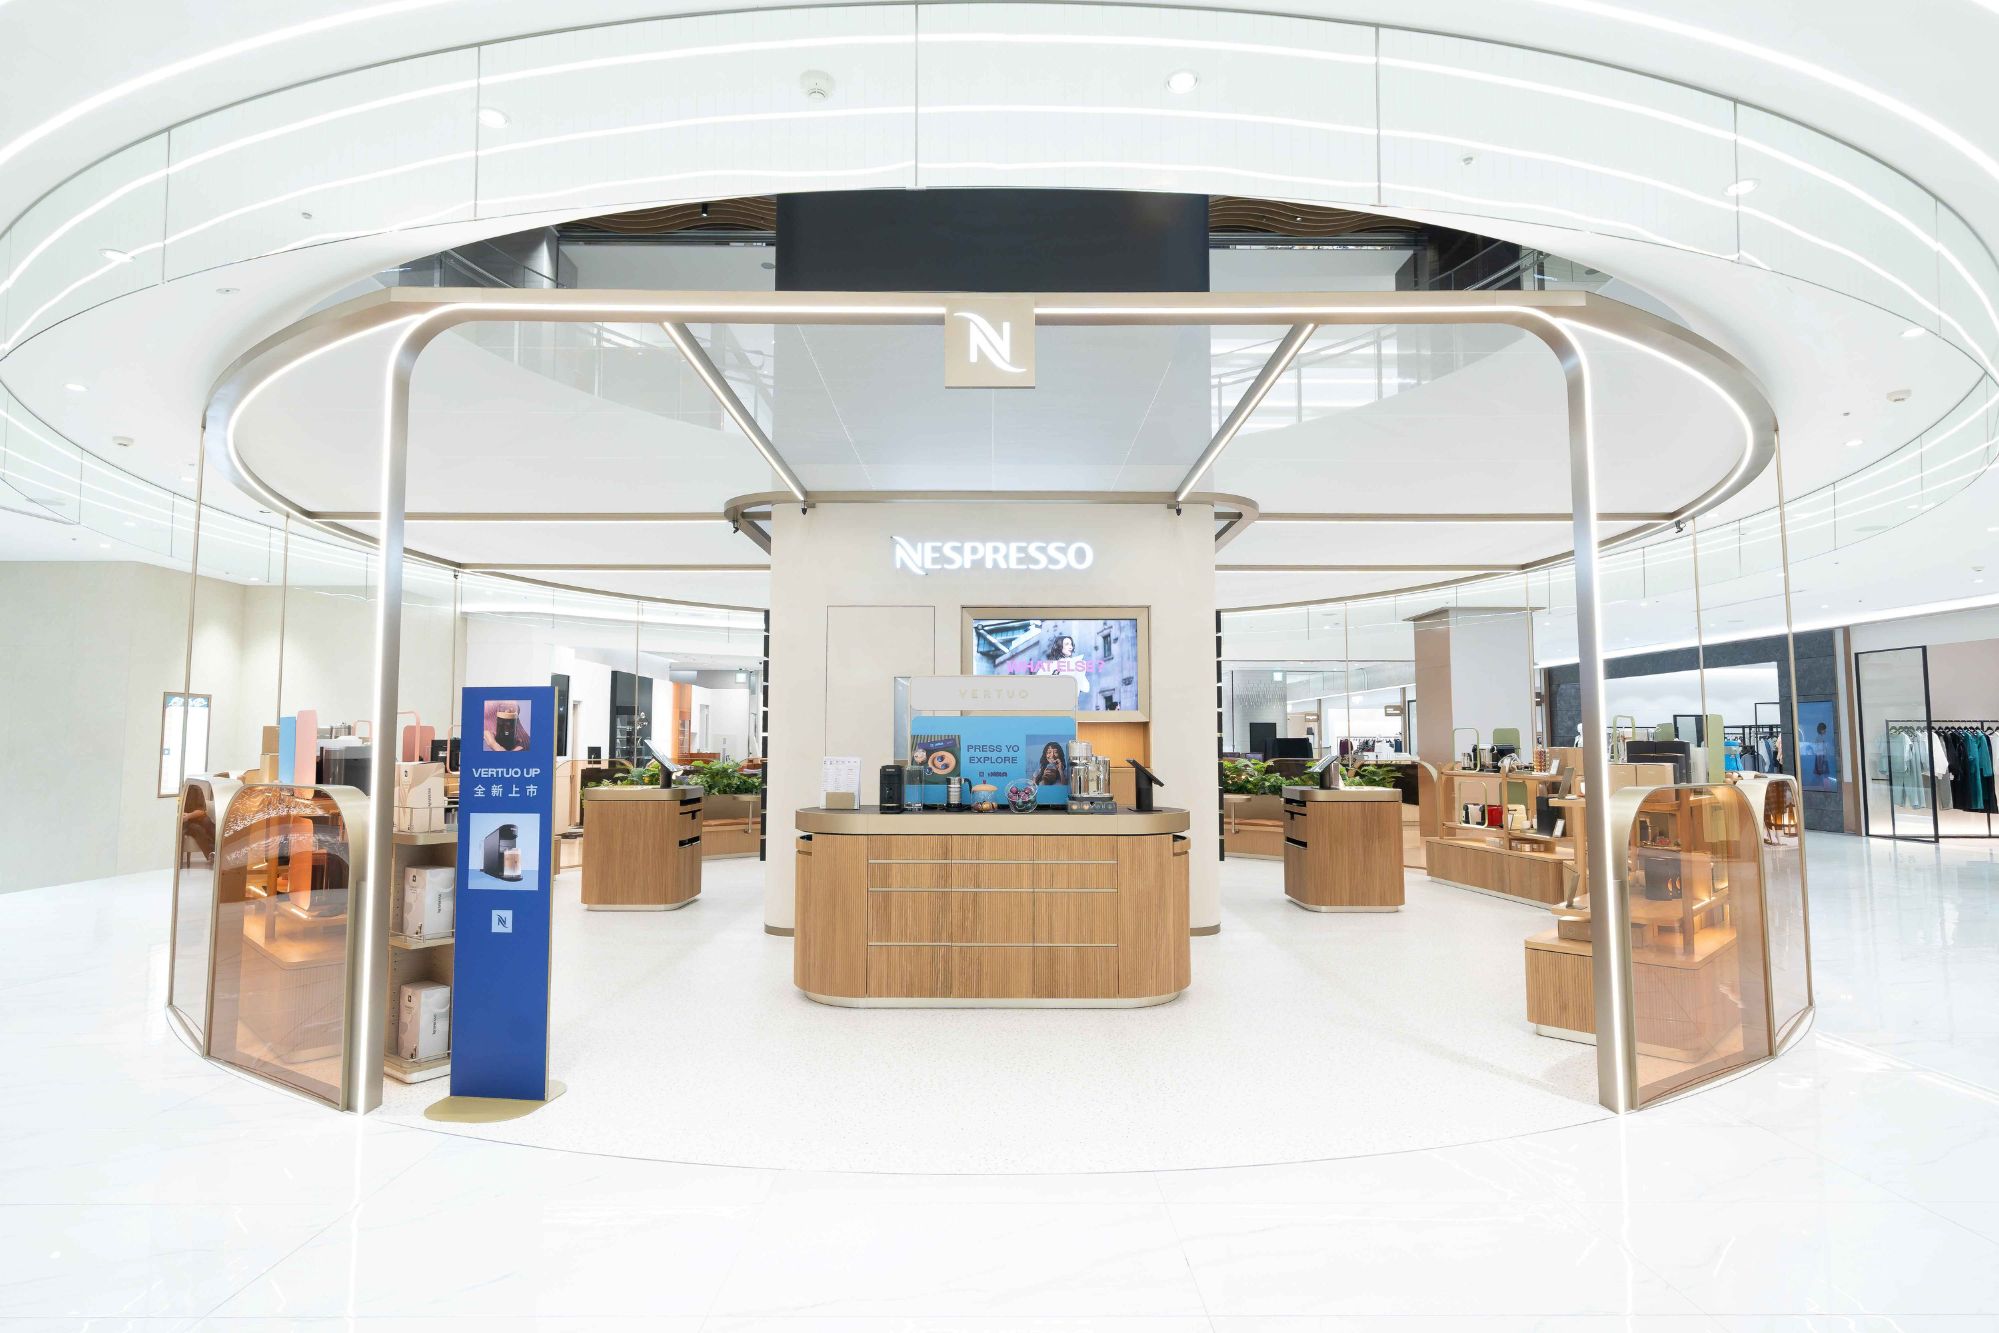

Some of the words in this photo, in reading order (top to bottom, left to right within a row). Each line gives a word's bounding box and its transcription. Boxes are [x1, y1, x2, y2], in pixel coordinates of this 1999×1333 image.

[890, 535, 1095, 576] NESPRESSO
[1006, 660, 1054, 673] WHAT
[959, 688, 1030, 699] VERTUO
[967, 744, 1003, 753] PRESS
[1005, 744, 1020, 753] YO
[969, 756, 1018, 764] EXPLORE
[472, 768, 522, 778] VERTUO
[523, 768, 541, 778] UP
[474, 784, 538, 798] 全新上市
